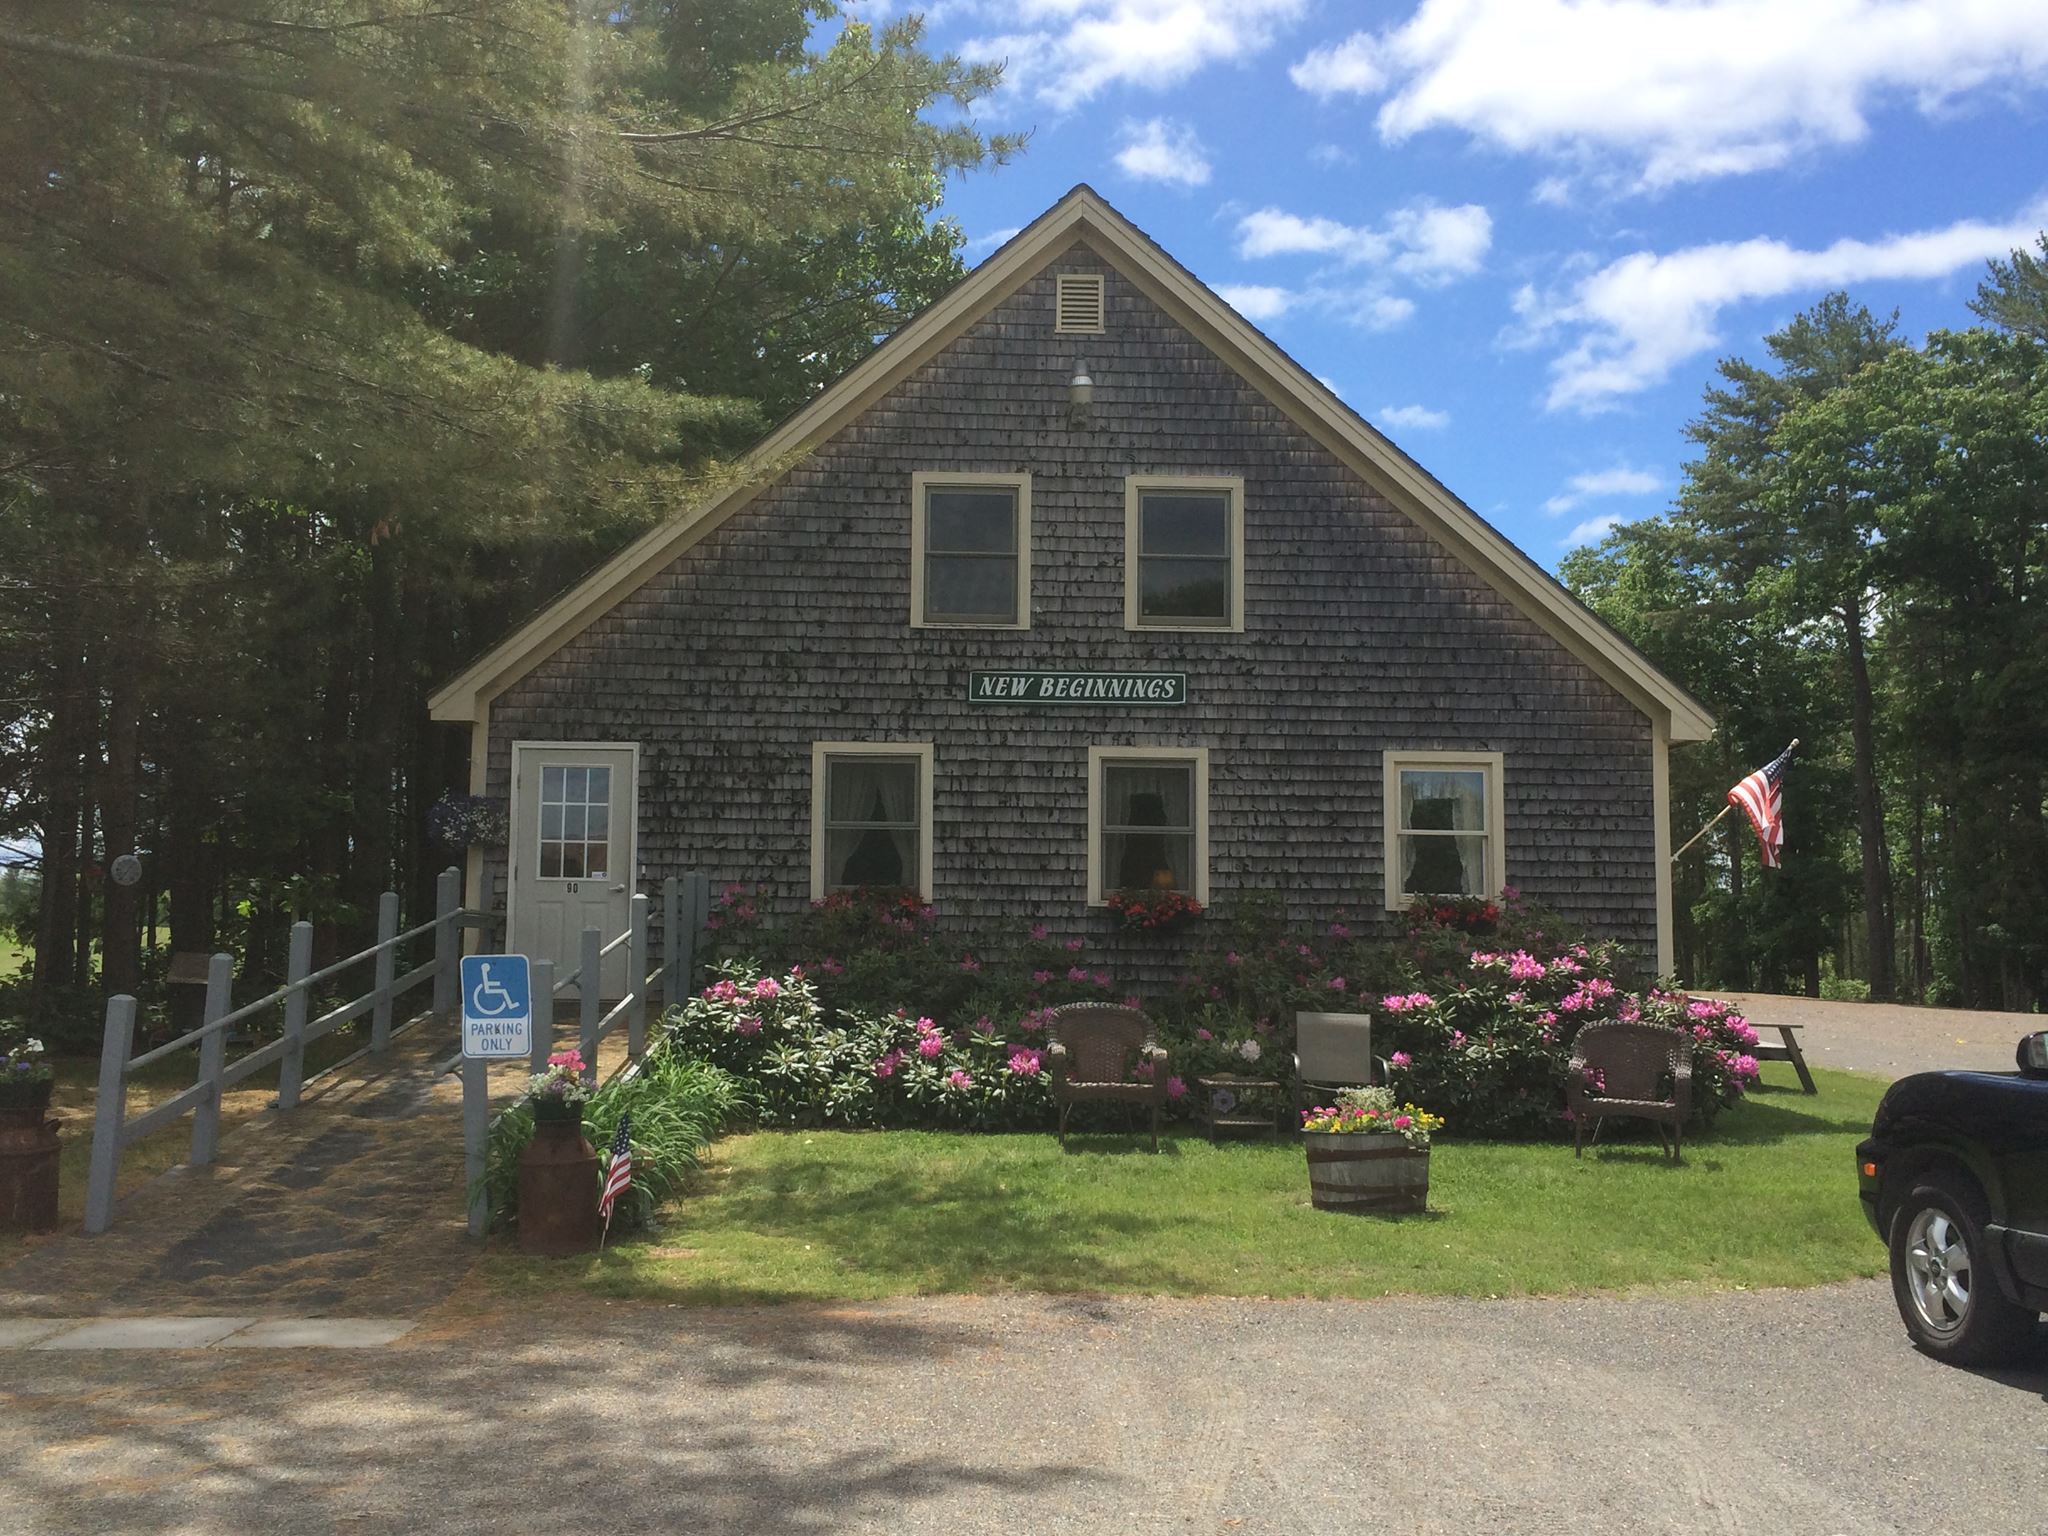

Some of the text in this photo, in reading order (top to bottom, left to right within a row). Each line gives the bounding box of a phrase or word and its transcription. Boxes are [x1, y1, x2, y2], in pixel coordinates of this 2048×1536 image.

[979, 676, 1176, 699] NEW BEGINNINGS
[566, 882, 578, 894] 90
[471, 1022, 523, 1036] PARKING
[481, 1038, 513, 1051] ONLY
